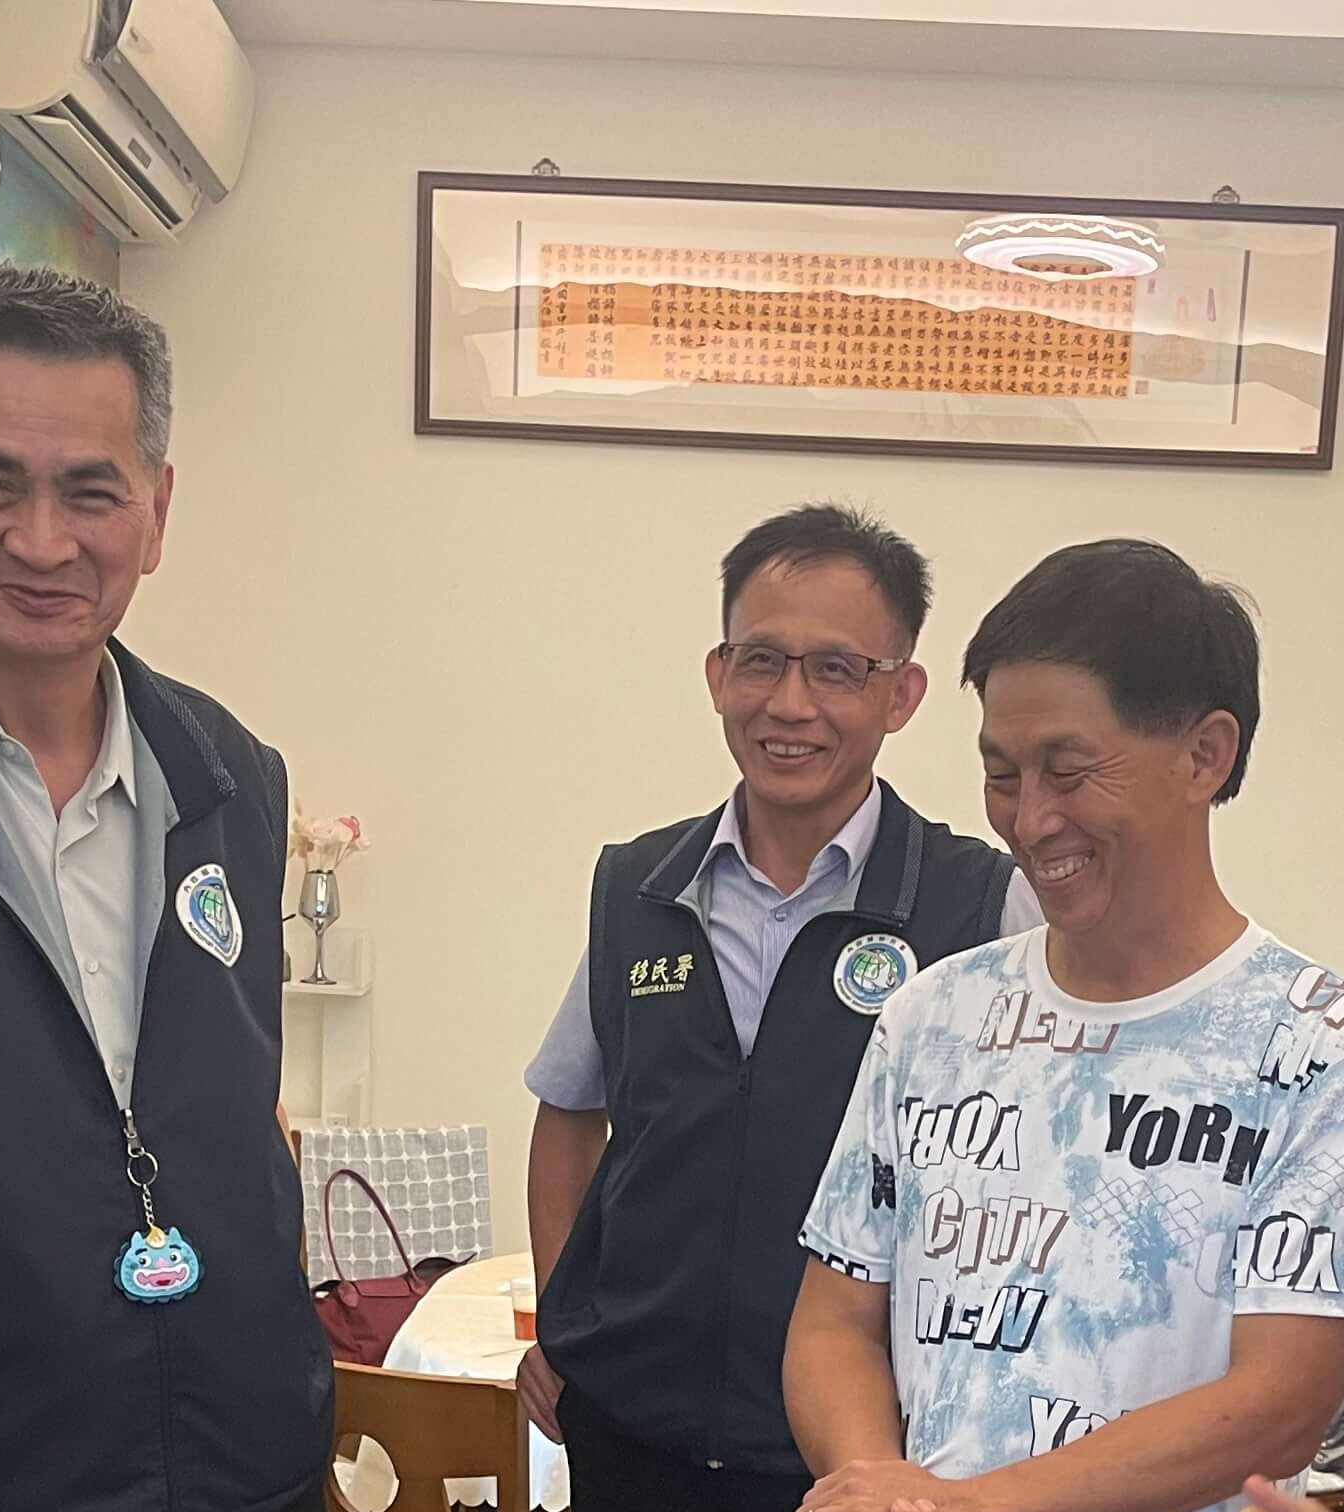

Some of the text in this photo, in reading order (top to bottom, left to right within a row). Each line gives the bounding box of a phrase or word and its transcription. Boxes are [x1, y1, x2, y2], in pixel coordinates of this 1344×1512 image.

[628, 953, 695, 987] 移民署
[630, 982, 686, 997] IMMIGRATION
[975, 988, 1121, 1053] NEW
[921, 1186, 1070, 1274] CITY
[913, 1277, 1050, 1352] NEW
